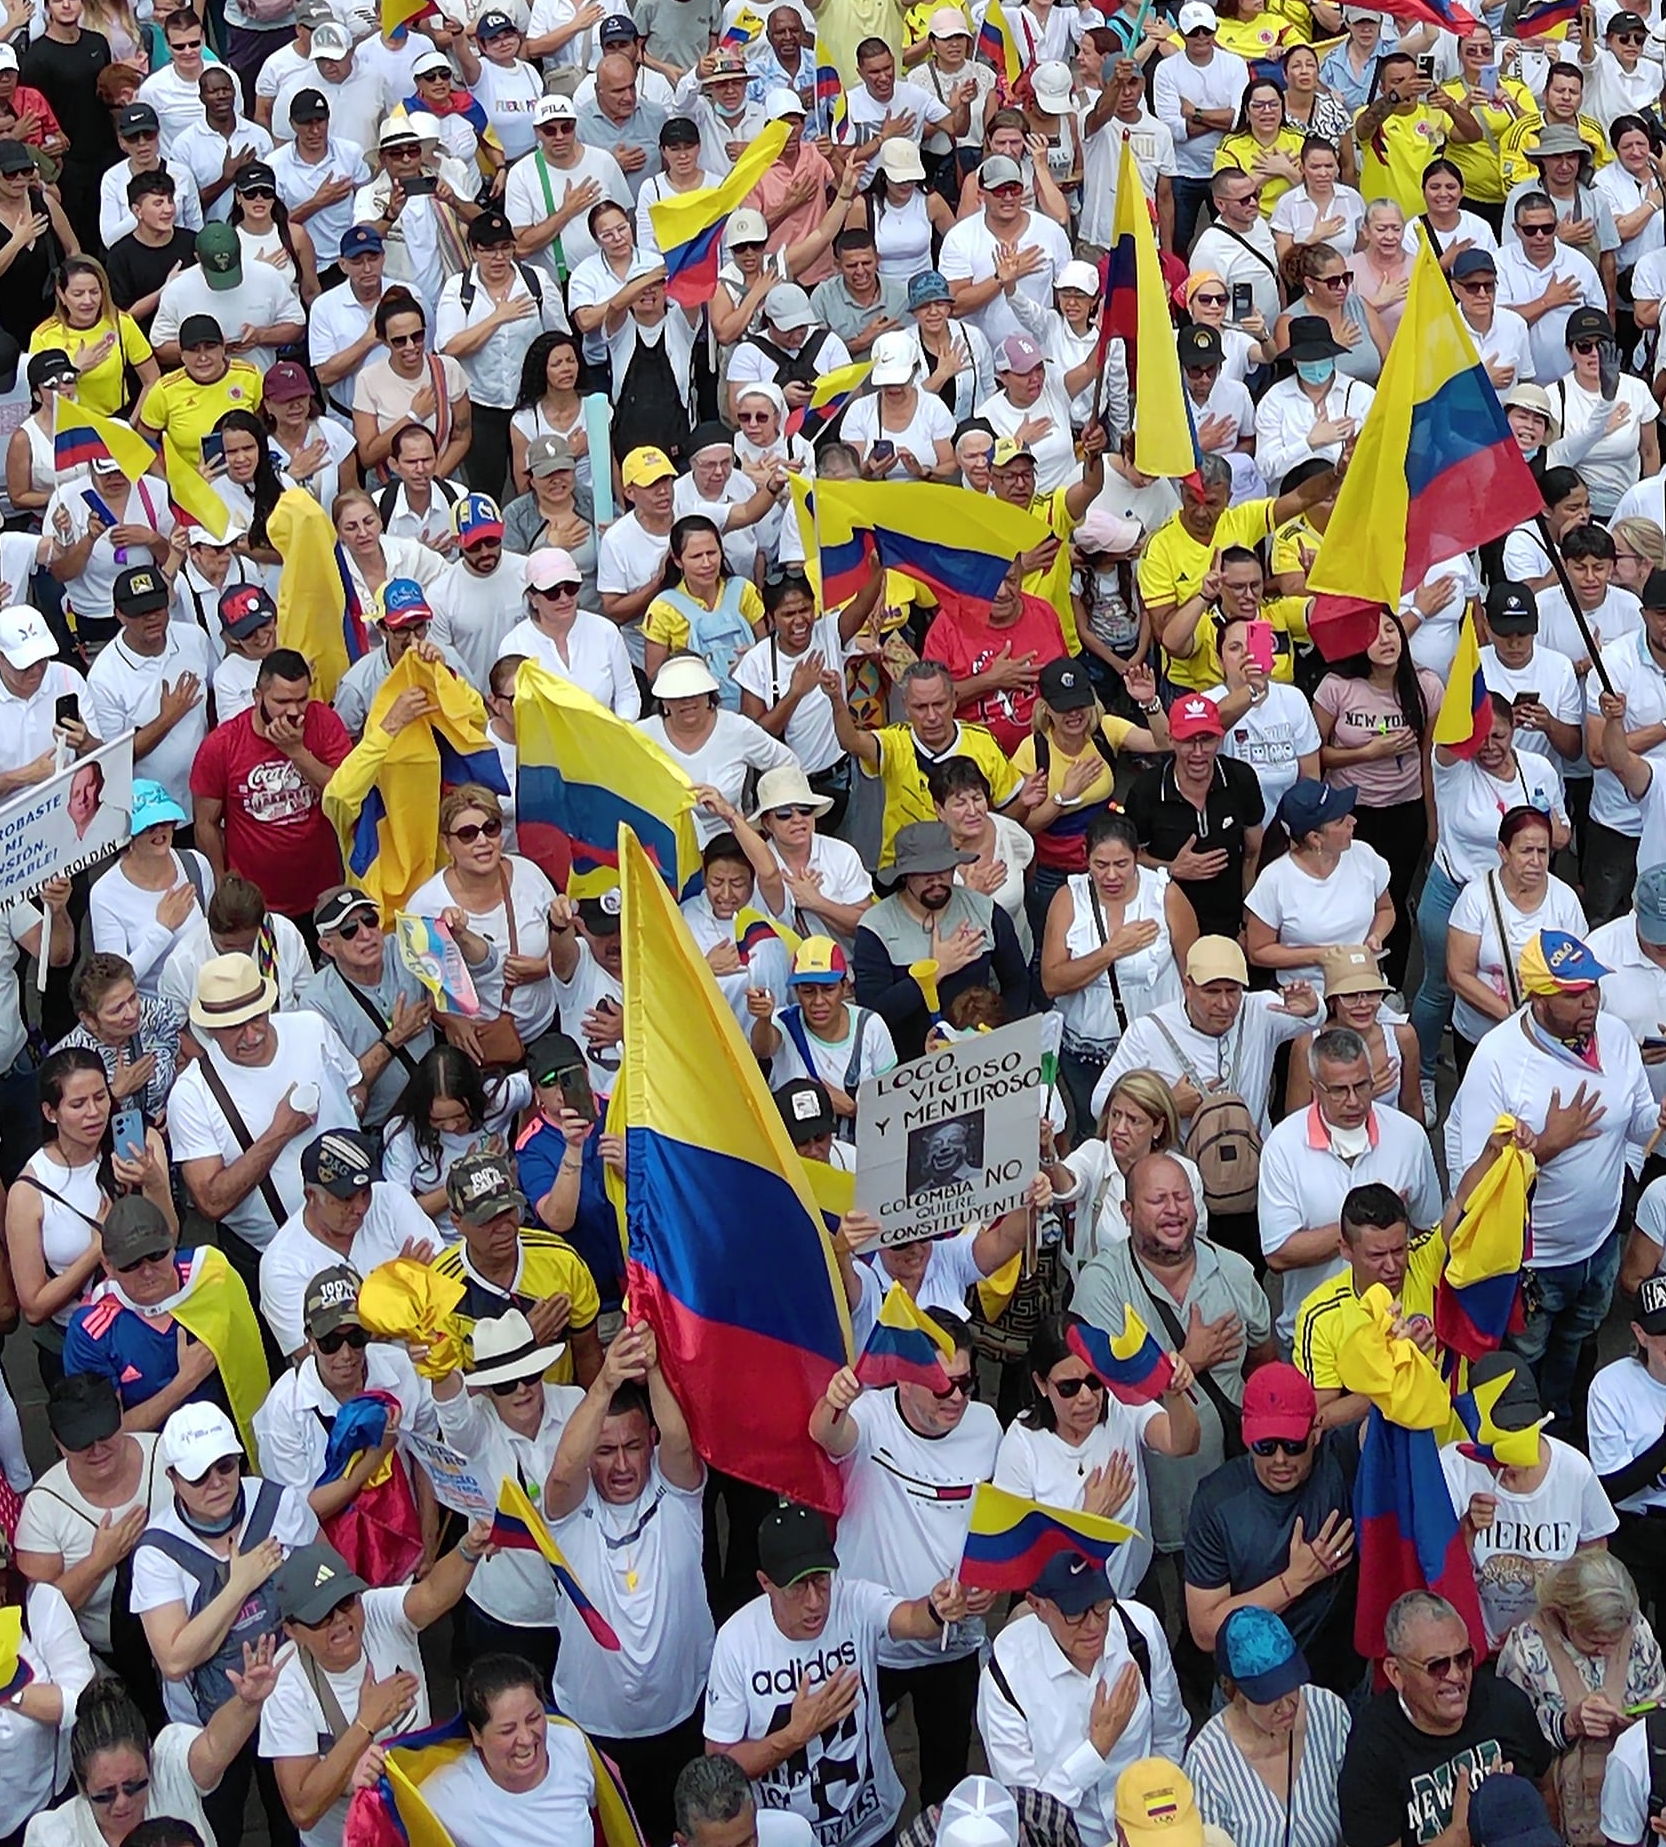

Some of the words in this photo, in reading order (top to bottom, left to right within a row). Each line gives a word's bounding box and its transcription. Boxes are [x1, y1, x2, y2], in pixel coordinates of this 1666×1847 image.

[540, 104, 568, 116] FILA
[1344, 712, 1375, 727] NEW
[4, 835, 24, 855] MI
[63, 839, 119, 879] ROLDÁN
[909, 1052, 1021, 1102] VICIOSO
[874, 1117, 891, 1137] Y
[903, 1067, 1042, 1129] MENTIROSO
[879, 1181, 974, 1216] COLOMBIA
[984, 1159, 1023, 1189] NO
[915, 1195, 977, 1220] QUIERE
[879, 1191, 1031, 1245] CONSTITUYENTE
[751, 1640, 858, 1697] adidas
